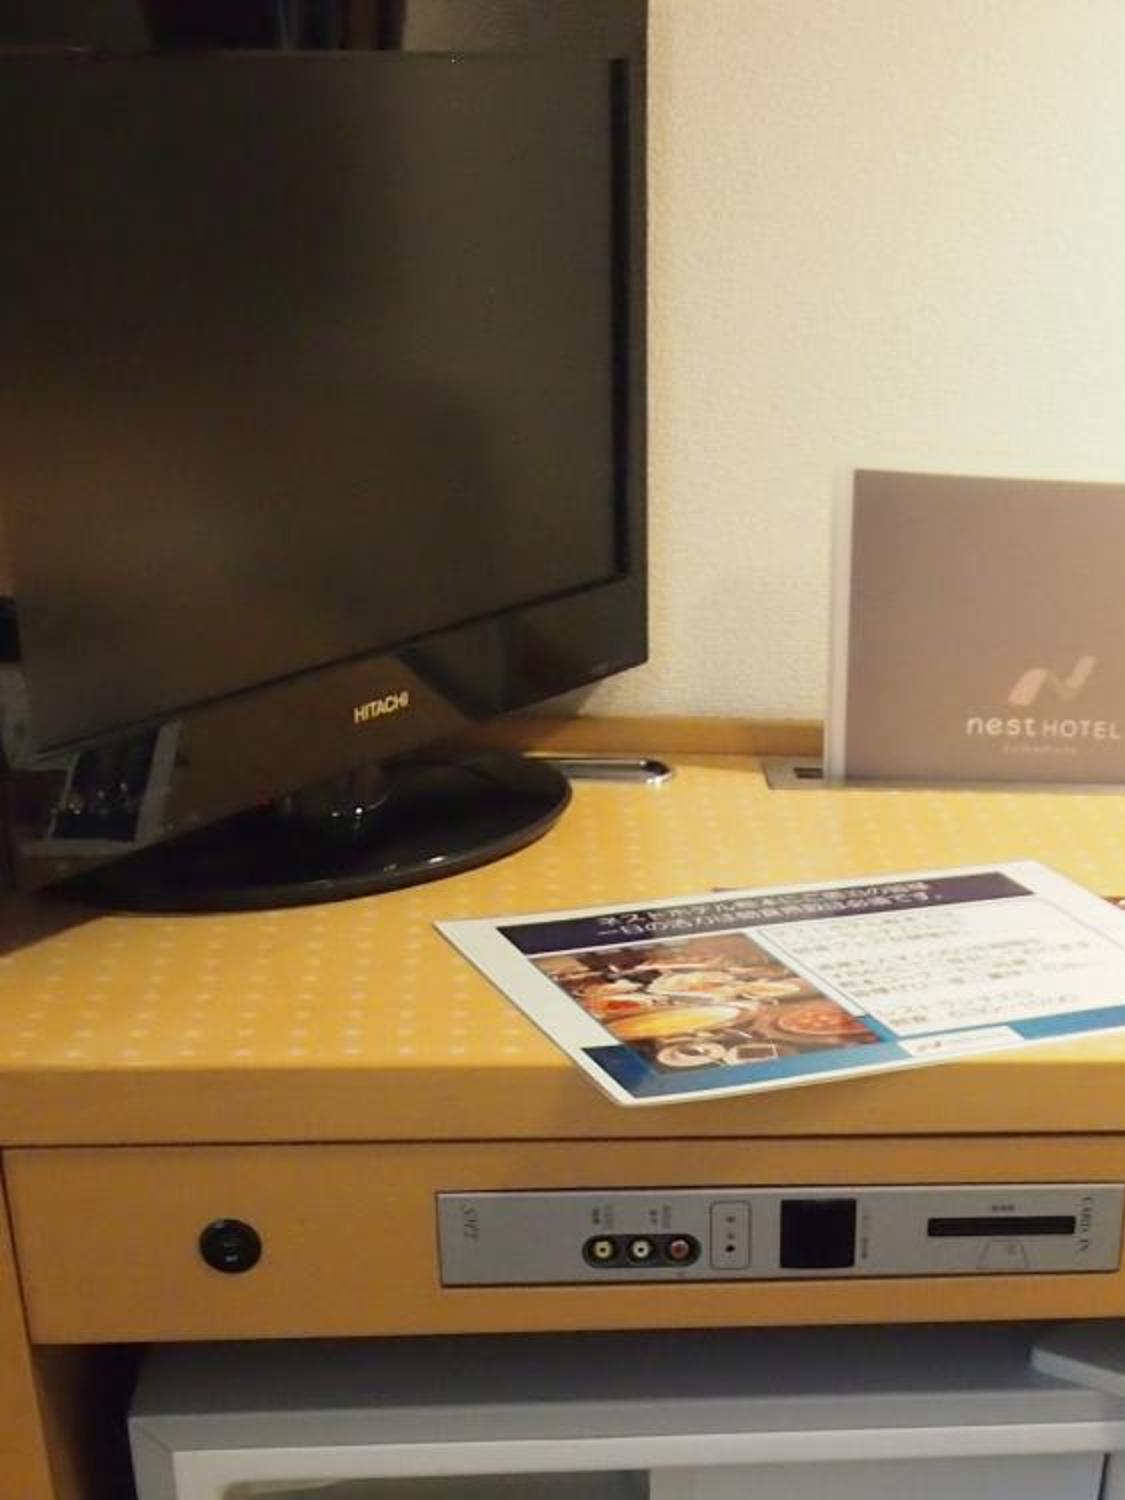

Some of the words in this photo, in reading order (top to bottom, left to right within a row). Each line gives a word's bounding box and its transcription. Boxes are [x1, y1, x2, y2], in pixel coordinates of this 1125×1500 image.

[353, 691, 409, 723] HITACHI
[966, 716, 1036, 736] nest
[1041, 719, 1121, 740] HOTEL
